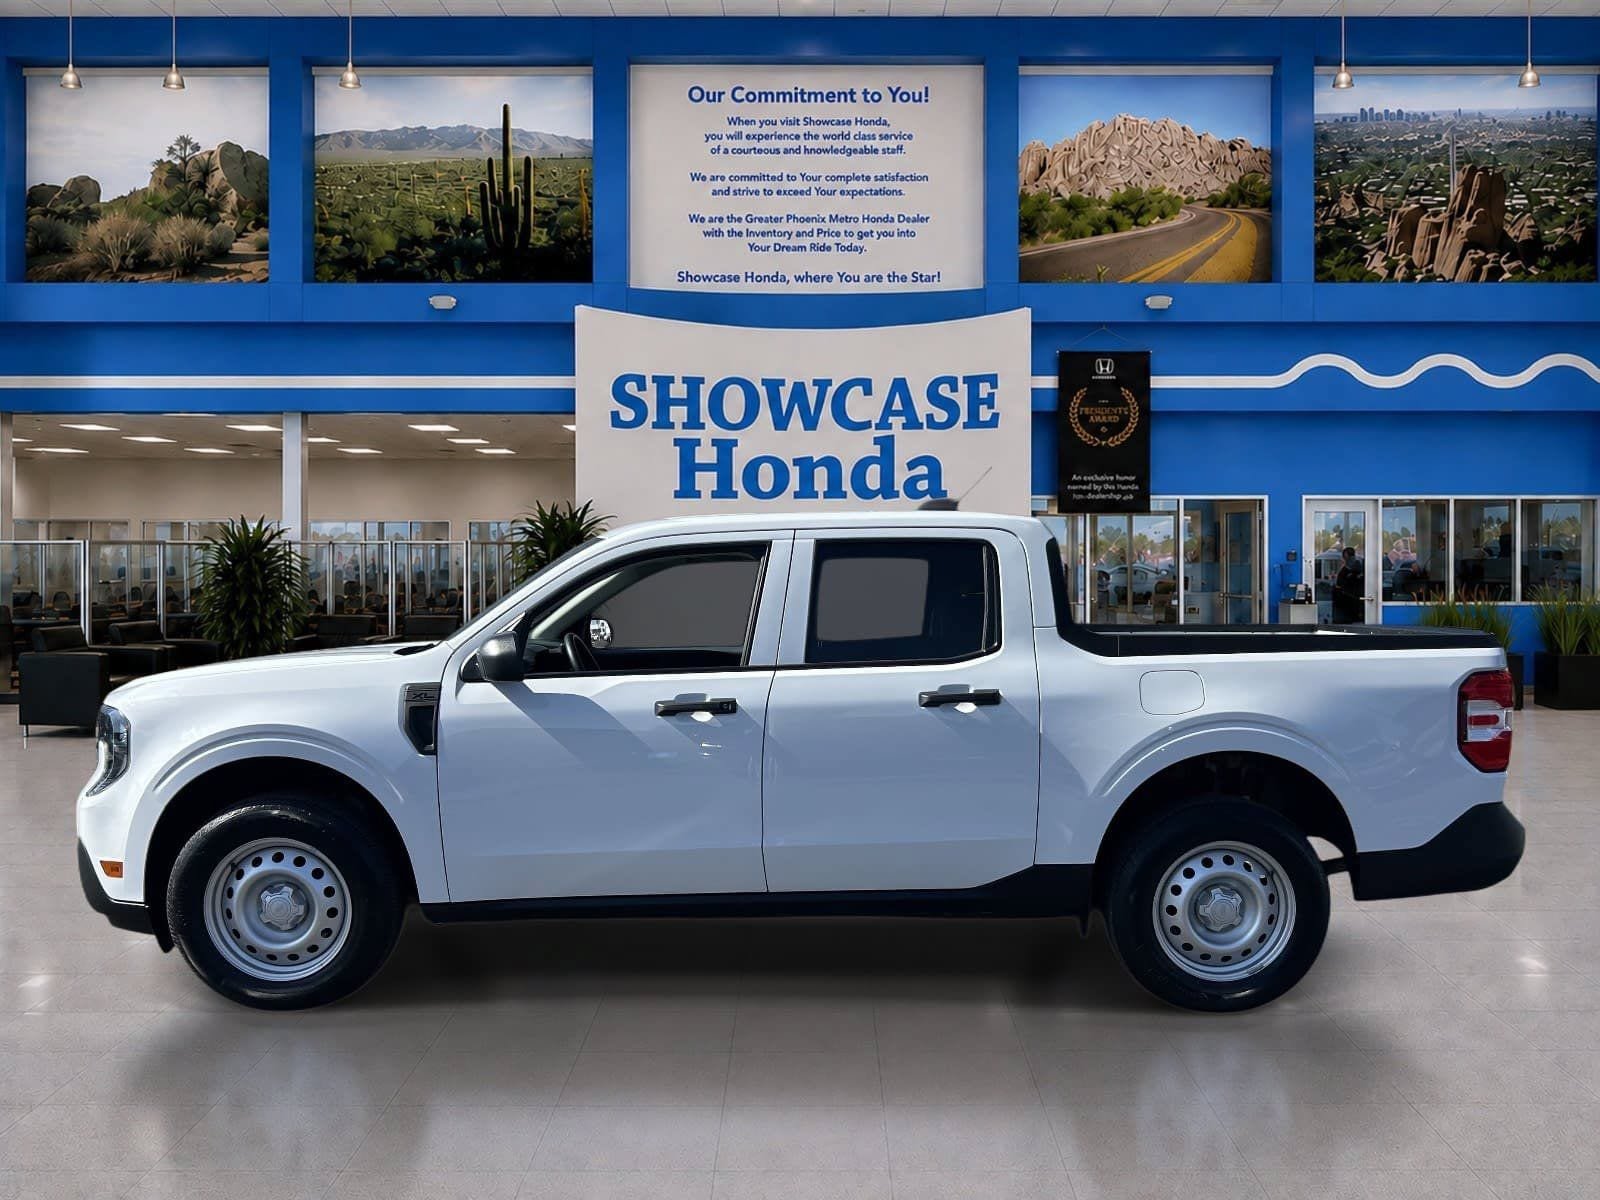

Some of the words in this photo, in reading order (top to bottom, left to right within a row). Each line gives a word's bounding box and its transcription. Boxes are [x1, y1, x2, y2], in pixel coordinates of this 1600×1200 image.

[687, 85, 726, 104] Our
[730, 85, 857, 104] Commitment
[861, 87, 883, 104] to
[886, 85, 930, 104] You!
[726, 116, 757, 127] When
[758, 118, 778, 129] you
[779, 116, 801, 127] visit
[802, 116, 853, 127] Showcase
[854, 116, 891, 128] Honda,
[704, 133, 724, 144] you
[725, 130, 744, 141] will
[745, 130, 801, 144] experience
[802, 130, 820, 141] the
[821, 130, 851, 141] world
[852, 130, 877, 141] class
[878, 130, 914, 142] service
[710, 144, 721, 155] of
[722, 147, 730, 155] a
[730, 146, 781, 156] courteous
[782, 144, 802, 155] and
[881, 144, 906, 155] staff.
[689, 172, 708, 183] We
[709, 174, 726, 182] are
[728, 171, 784, 183] committed
[785, 173, 798, 183] to
[799, 172, 823, 183] Your
[824, 172, 872, 185] complete
[873, 171, 929, 183] satisfaction
[711, 185, 731, 197] and
[732, 186, 761, 197] strive
[762, 187, 774, 197] to
[775, 186, 812, 197] exceed
[814, 186, 838, 197] Your
[839, 186, 906, 200] expectations.
[688, 213, 706, 224] We
[707, 215, 725, 224] are
[725, 213, 744, 224] the
[744, 213, 785, 224] Greater
[785, 213, 827, 224] Phoenix
[828, 213, 860, 224] Metro
[861, 213, 895, 224] Honda
[897, 213, 931, 224] Dealer
[702, 227, 725, 238] with
[726, 227, 744, 238] the
[745, 227, 794, 241] Inventory
[795, 227, 815, 239] and
[816, 227, 842, 239] Price
[843, 229, 855, 238] to
[856, 229, 875, 241] get
[876, 230, 895, 241] you
[896, 227, 917, 238] into
[747, 242, 772, 253] Your
[773, 242, 808, 253] Dream
[809, 242, 833, 253] Ride
[833, 242, 868, 255] Today.
[677, 270, 741, 284] Showcase
[744, 270, 790, 286] Honda,
[793, 270, 834, 284] where
[836, 271, 861, 284] You
[863, 274, 884, 284] are
[886, 270, 908, 284] the
[911, 271, 941, 284] Star!
[610, 373, 1000, 431] SHOWCASE
[673, 434, 947, 501] Honda
[1093, 483, 1103, 493] by
